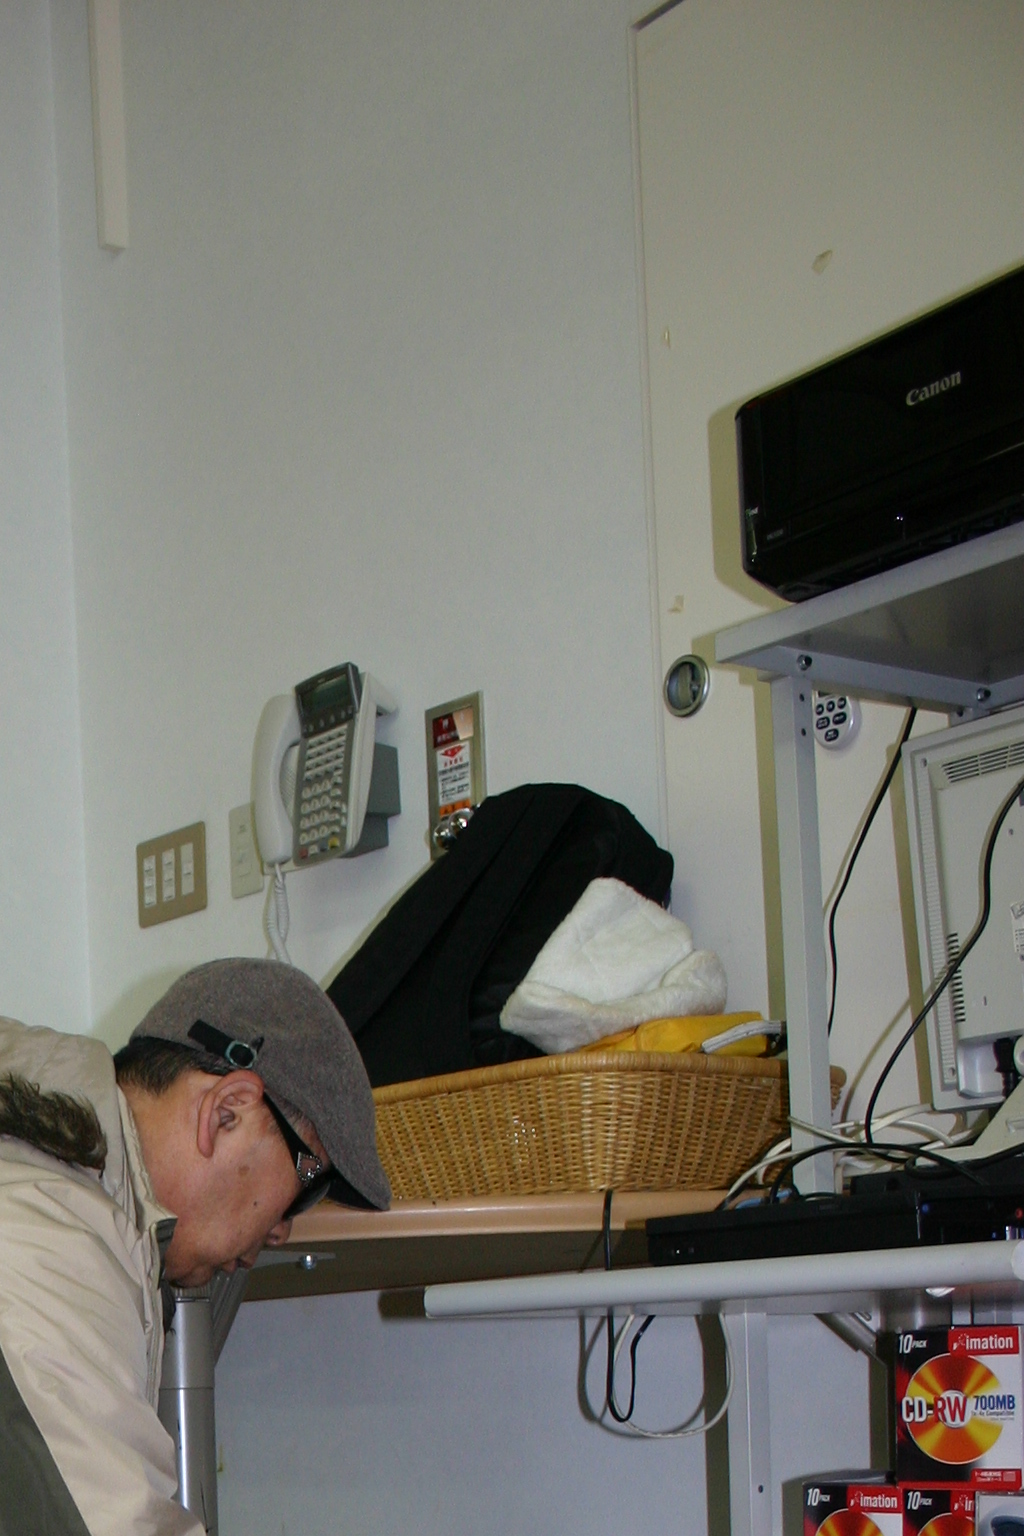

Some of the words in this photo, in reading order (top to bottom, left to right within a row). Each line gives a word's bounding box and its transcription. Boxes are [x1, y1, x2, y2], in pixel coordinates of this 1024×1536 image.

[905, 371, 961, 406] Canon
[898, 1334, 913, 1354] 10
[965, 1334, 1014, 1351] imation
[901, 1395, 968, 1424] CD-RW
[973, 1394, 1016, 1411] 700MB
[807, 1488, 820, 1507] 10
[859, 1493, 898, 1509] imation
[907, 1491, 921, 1510] 10
